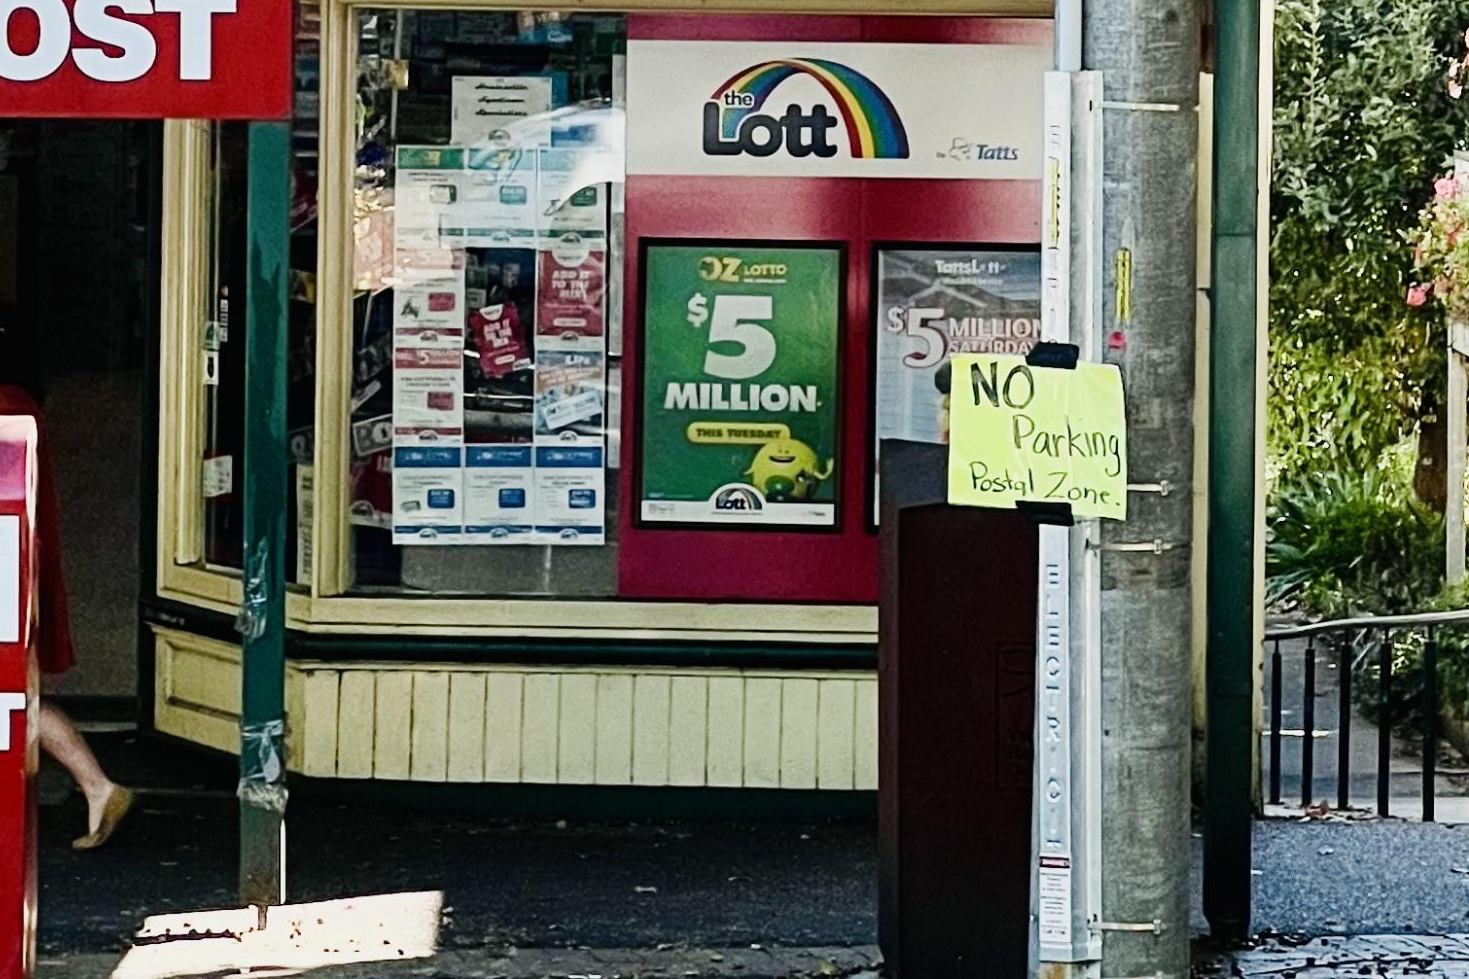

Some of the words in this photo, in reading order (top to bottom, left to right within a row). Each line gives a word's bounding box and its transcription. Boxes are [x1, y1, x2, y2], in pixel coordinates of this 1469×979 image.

[724, 91, 753, 106] the
[703, 101, 838, 158] Lott
[976, 144, 1018, 160] Tatts
[698, 256, 742, 283] OZ
[744, 264, 787, 275] LOTTO
[687, 293, 776, 379] $5
[887, 306, 948, 368] $5
[970, 361, 1035, 410] NO
[696, 428, 723, 437] THIS
[727, 428, 782, 438] TUESDAY
[1012, 414, 1121, 476] Parking
[969, 460, 1034, 496] Postal
[1044, 471, 1121, 506] Zone.
